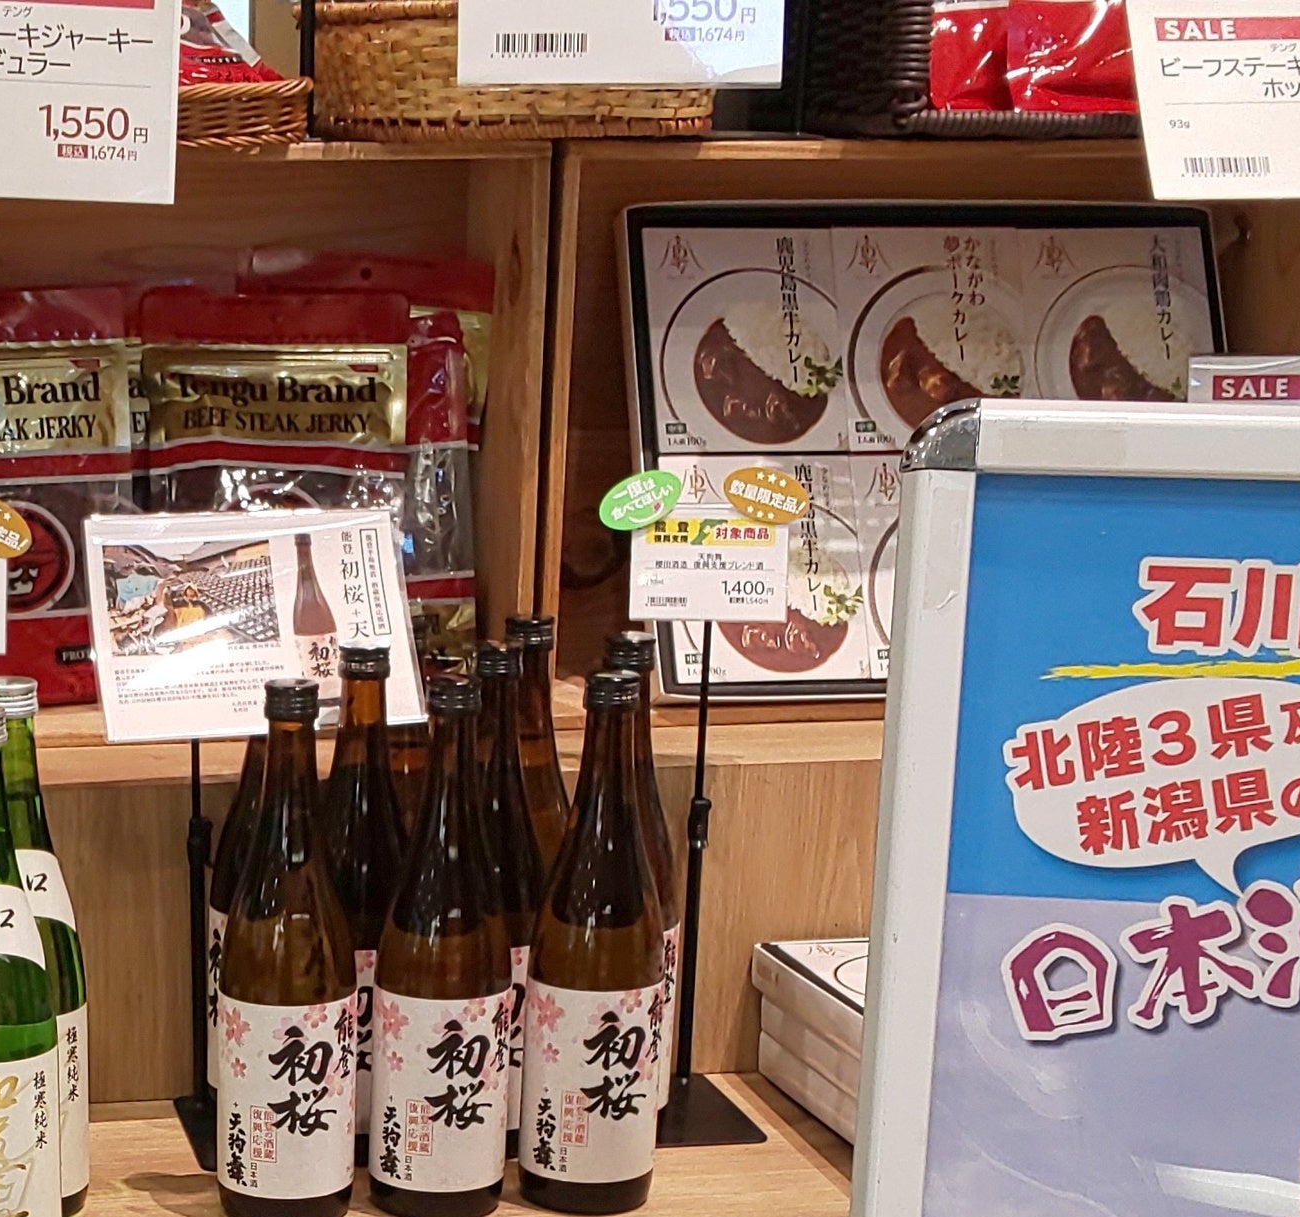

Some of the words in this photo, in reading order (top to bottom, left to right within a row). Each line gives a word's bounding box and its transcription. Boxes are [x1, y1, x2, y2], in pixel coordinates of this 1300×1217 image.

[1163, 20, 1237, 40] SALE
[1169, 119, 1191, 130] 93g
[2, 371, 102, 406] Brand
[275, 375, 378, 403] Brand
[1220, 377, 1290, 399] SALE
[35, 413, 98, 441] JERKY
[183, 406, 230, 432] BEEF
[235, 410, 300, 433] STEAK
[304, 411, 371, 434] JERKY
[715, 526, 770, 541] 対象商品
[65, 1026, 80, 1102] 極寒純米
[423, 1019, 493, 1131] 初桜
[579, 1010, 647, 1122] 初桜
[267, 1025, 338, 1137] 初桜
[33, 1071, 49, 1149] 極寒純米
